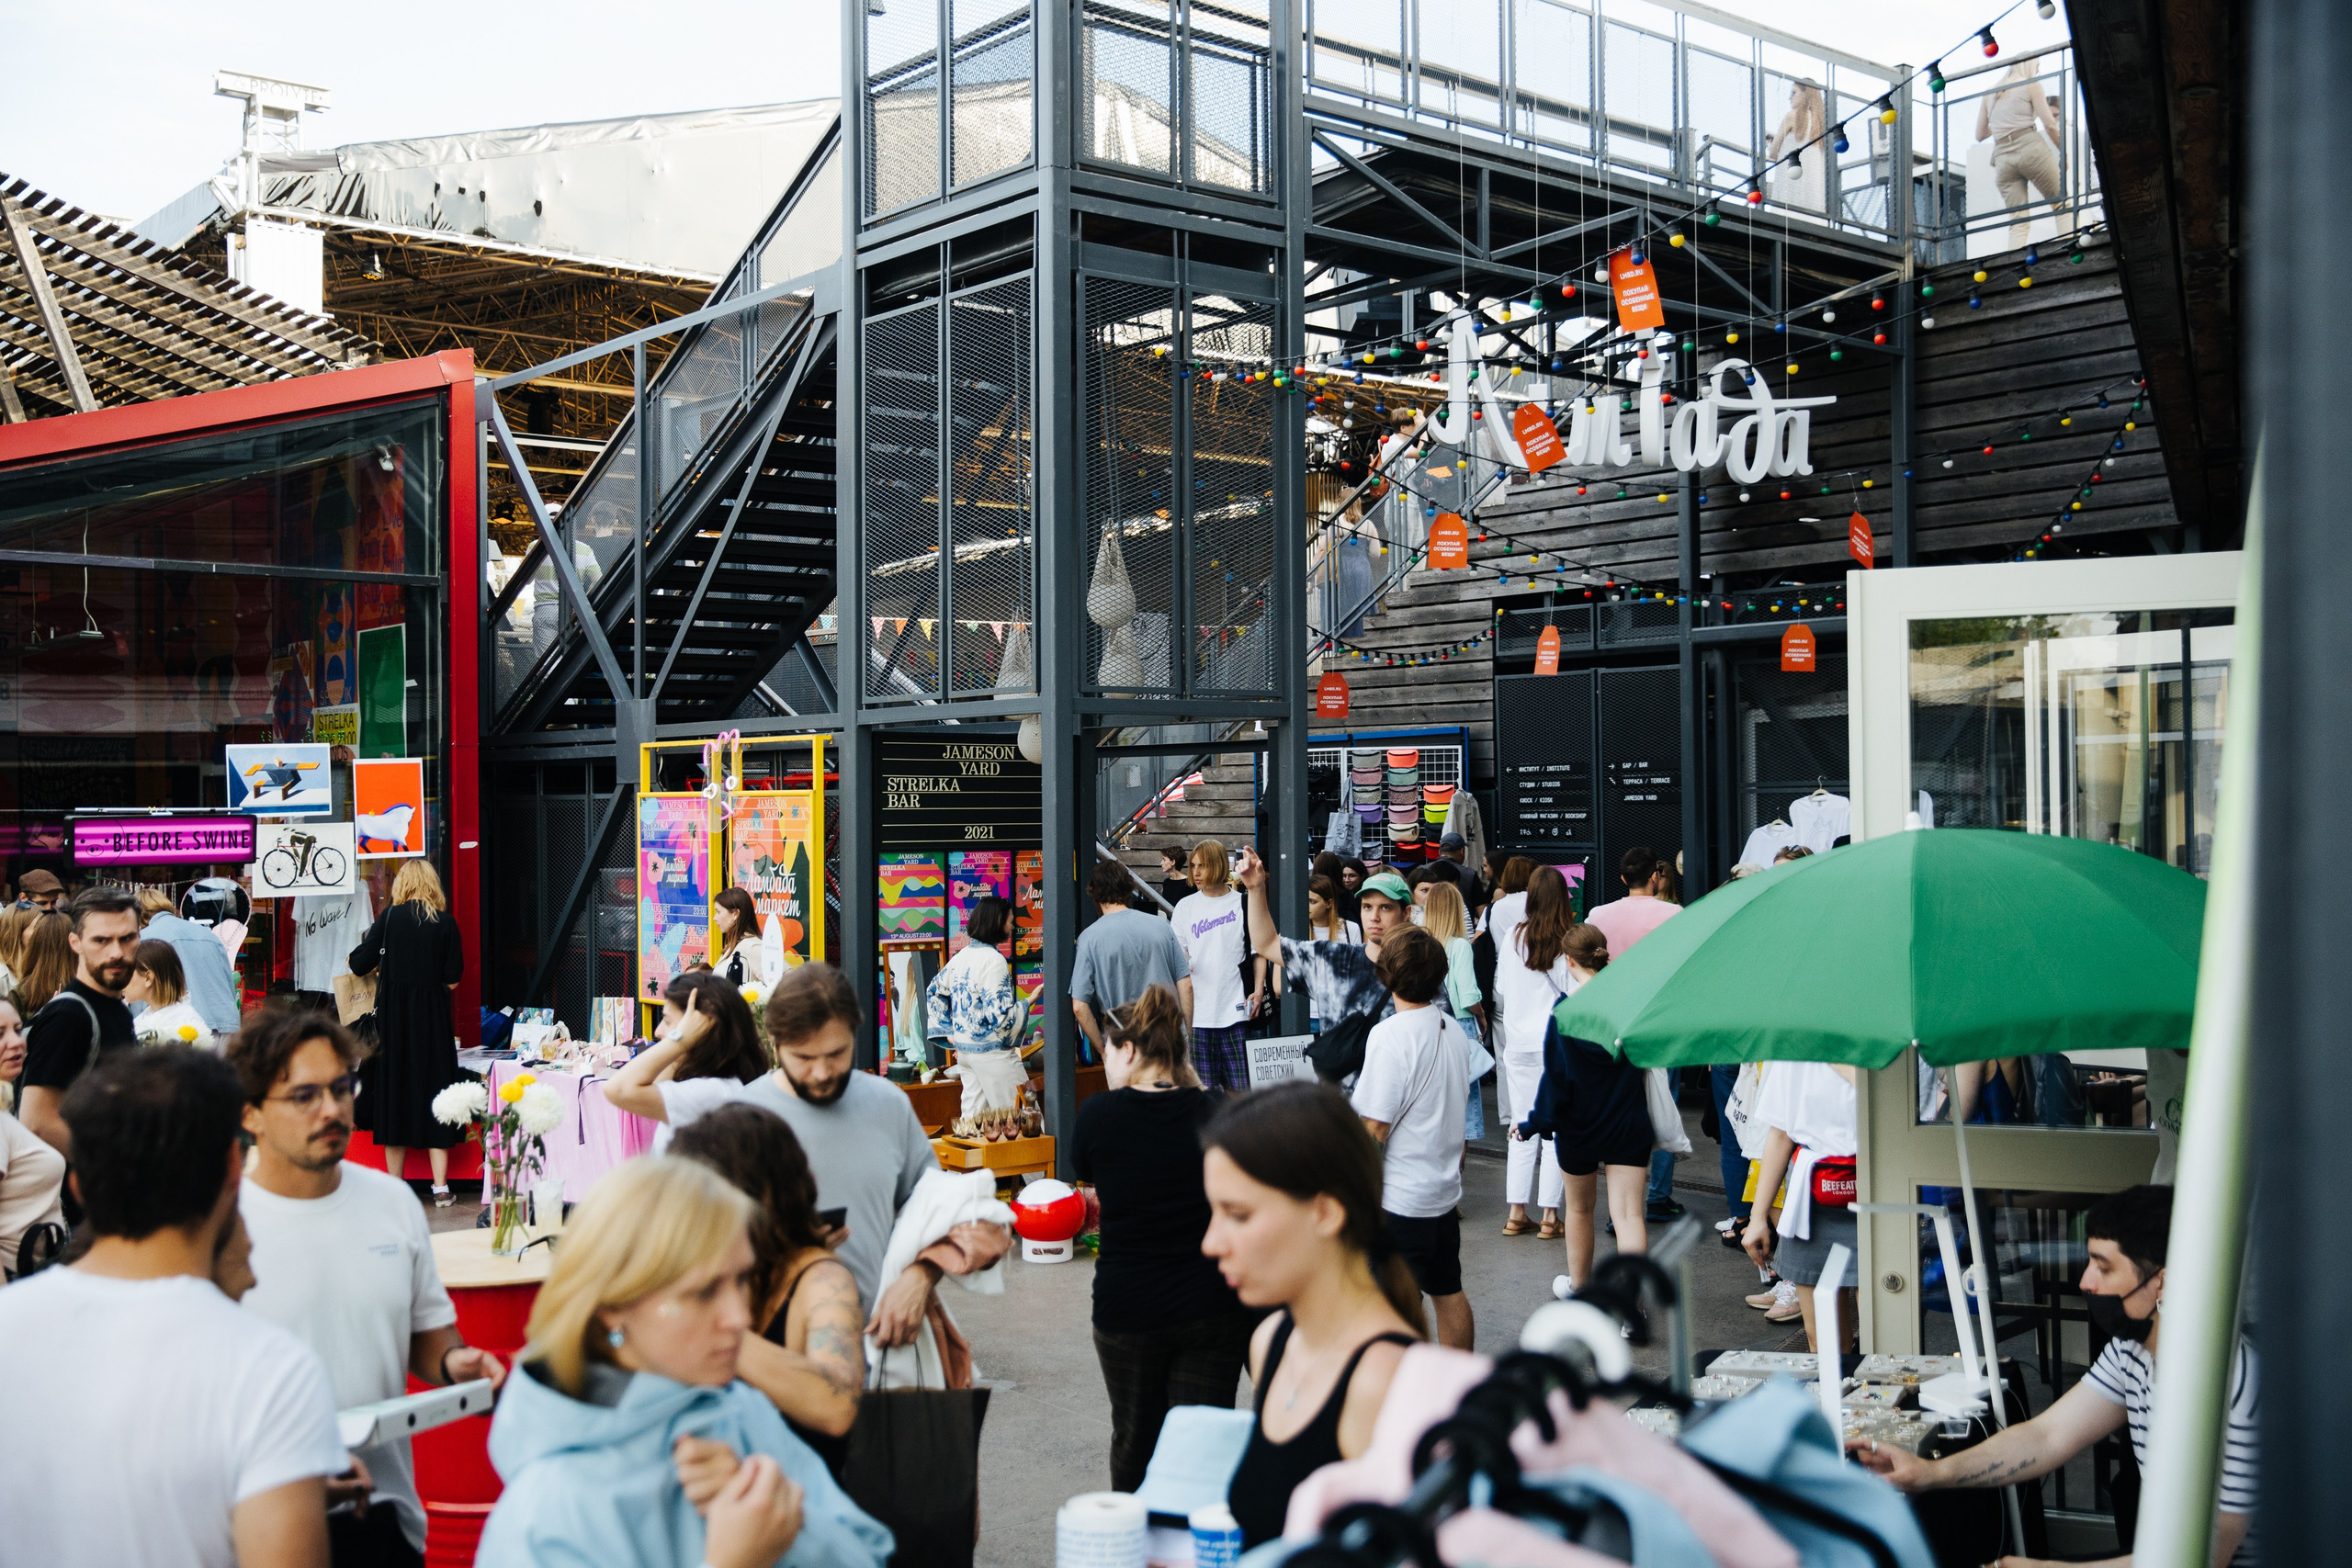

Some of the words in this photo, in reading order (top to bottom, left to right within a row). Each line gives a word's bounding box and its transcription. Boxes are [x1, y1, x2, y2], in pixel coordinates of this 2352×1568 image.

[1620, 268, 1644, 280] LMBD.RU
[1623, 284, 1648, 297] ПОКУПАЙ
[1621, 293, 1655, 306] ОСОБЕННЫЕ
[1632, 303, 1647, 313] ВЕЩИ
[1428, 310, 1837, 484] Лмбада
[1522, 421, 1544, 434] LMBD.RU
[1526, 432, 1550, 446] ПОКУПАЙ
[1526, 436, 1555, 454] ОСОБЕННЫЕ
[1536, 446, 1550, 457] ВЕЩИ
[319, 713, 355, 731] STRELKA
[943, 745, 1015, 760] JAMESON
[958, 761, 1001, 776] YARD
[888, 777, 961, 792] STRELKA
[662, 801, 689, 810] JAMESON
[756, 799, 787, 808] JAMESON
[888, 794, 921, 808] BAR
[668, 811, 684, 819] YARD
[763, 810, 782, 818] YARD
[643, 821, 669, 829] STRELKA
[735, 820, 764, 829] STRELKA
[643, 831, 655, 840] BAR
[735, 830, 748, 840] BAR
[965, 826, 995, 839] 2021
[113, 829, 250, 852] BEFORE.SWINE
[662, 857, 686, 873] Ламбада
[666, 874, 688, 887] маркет
[744, 863, 797, 894] Ламбада
[969, 883, 992, 892] Ламбада
[973, 891, 992, 899] маркет
[693, 907, 707, 916] 23:00
[753, 897, 801, 918] маркет
[305, 912, 317, 937] No
[1192, 909, 1237, 939] Vetements
[1254, 1041, 1305, 1063] СОВРЕМЕННЫЙ
[1256, 1060, 1295, 1081] СОВЕТСКИЙ
[1822, 1179, 1857, 1192] BEEFEAT
